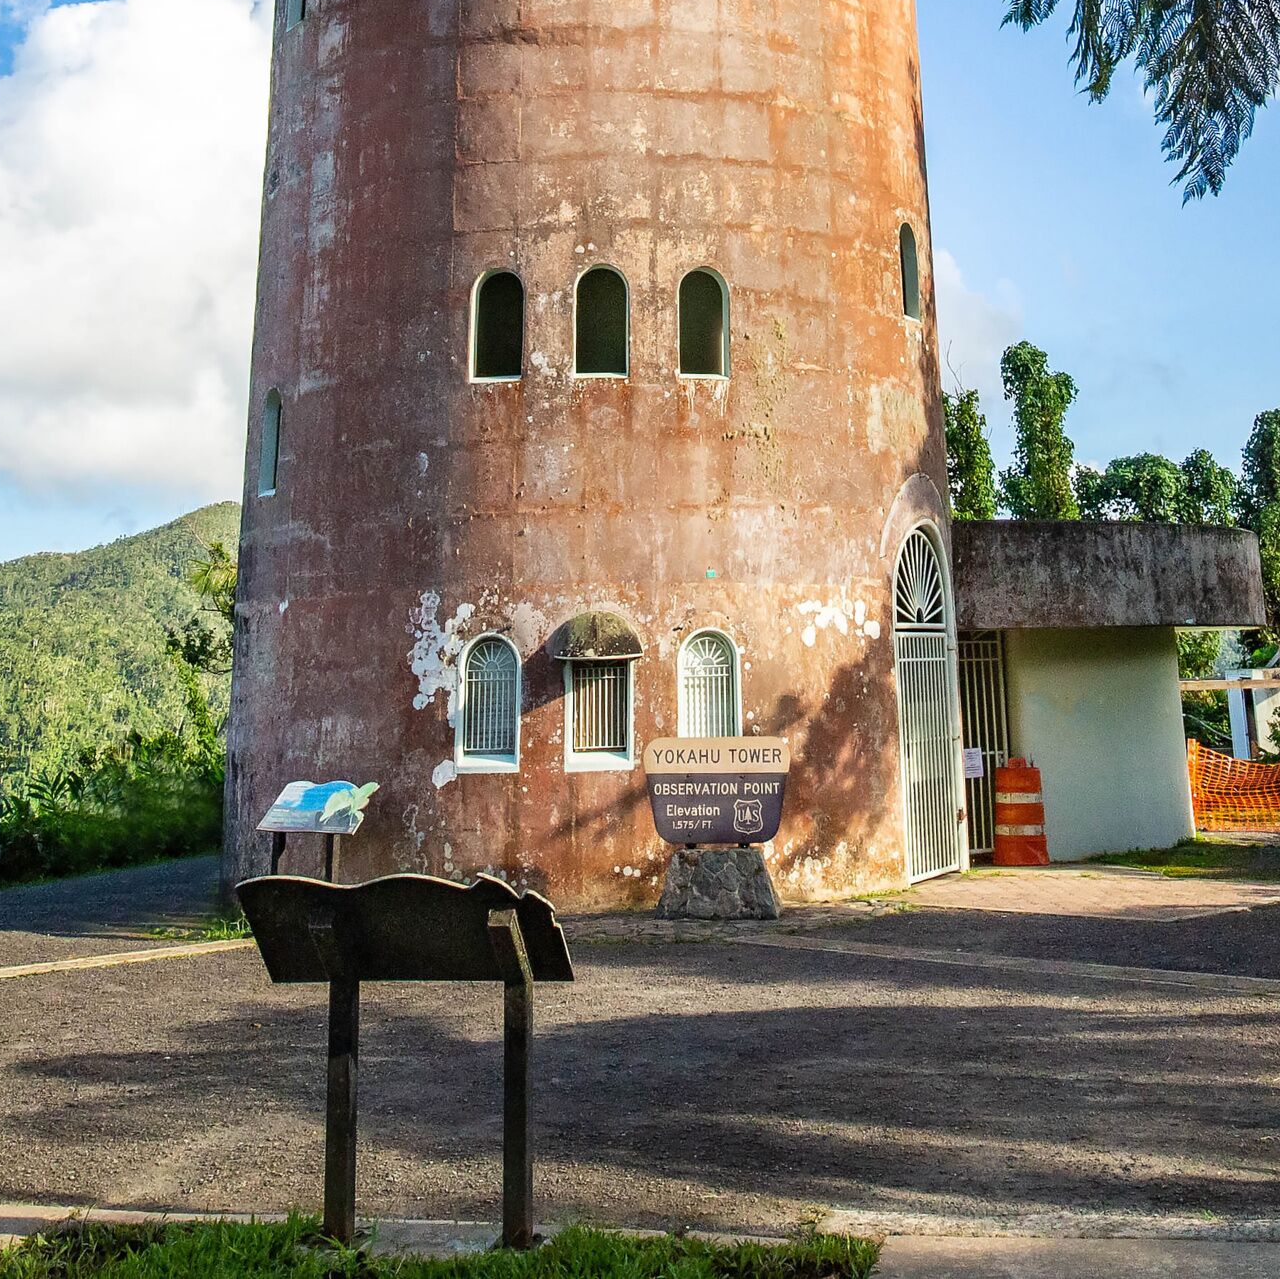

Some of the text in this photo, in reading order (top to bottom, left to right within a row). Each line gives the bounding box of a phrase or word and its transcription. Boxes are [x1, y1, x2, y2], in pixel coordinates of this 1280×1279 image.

[653, 748, 782, 764] YOKAHU TOWER
[654, 782, 780, 795] OBSERVATION POINT
[666, 804, 720, 816] Elevation
